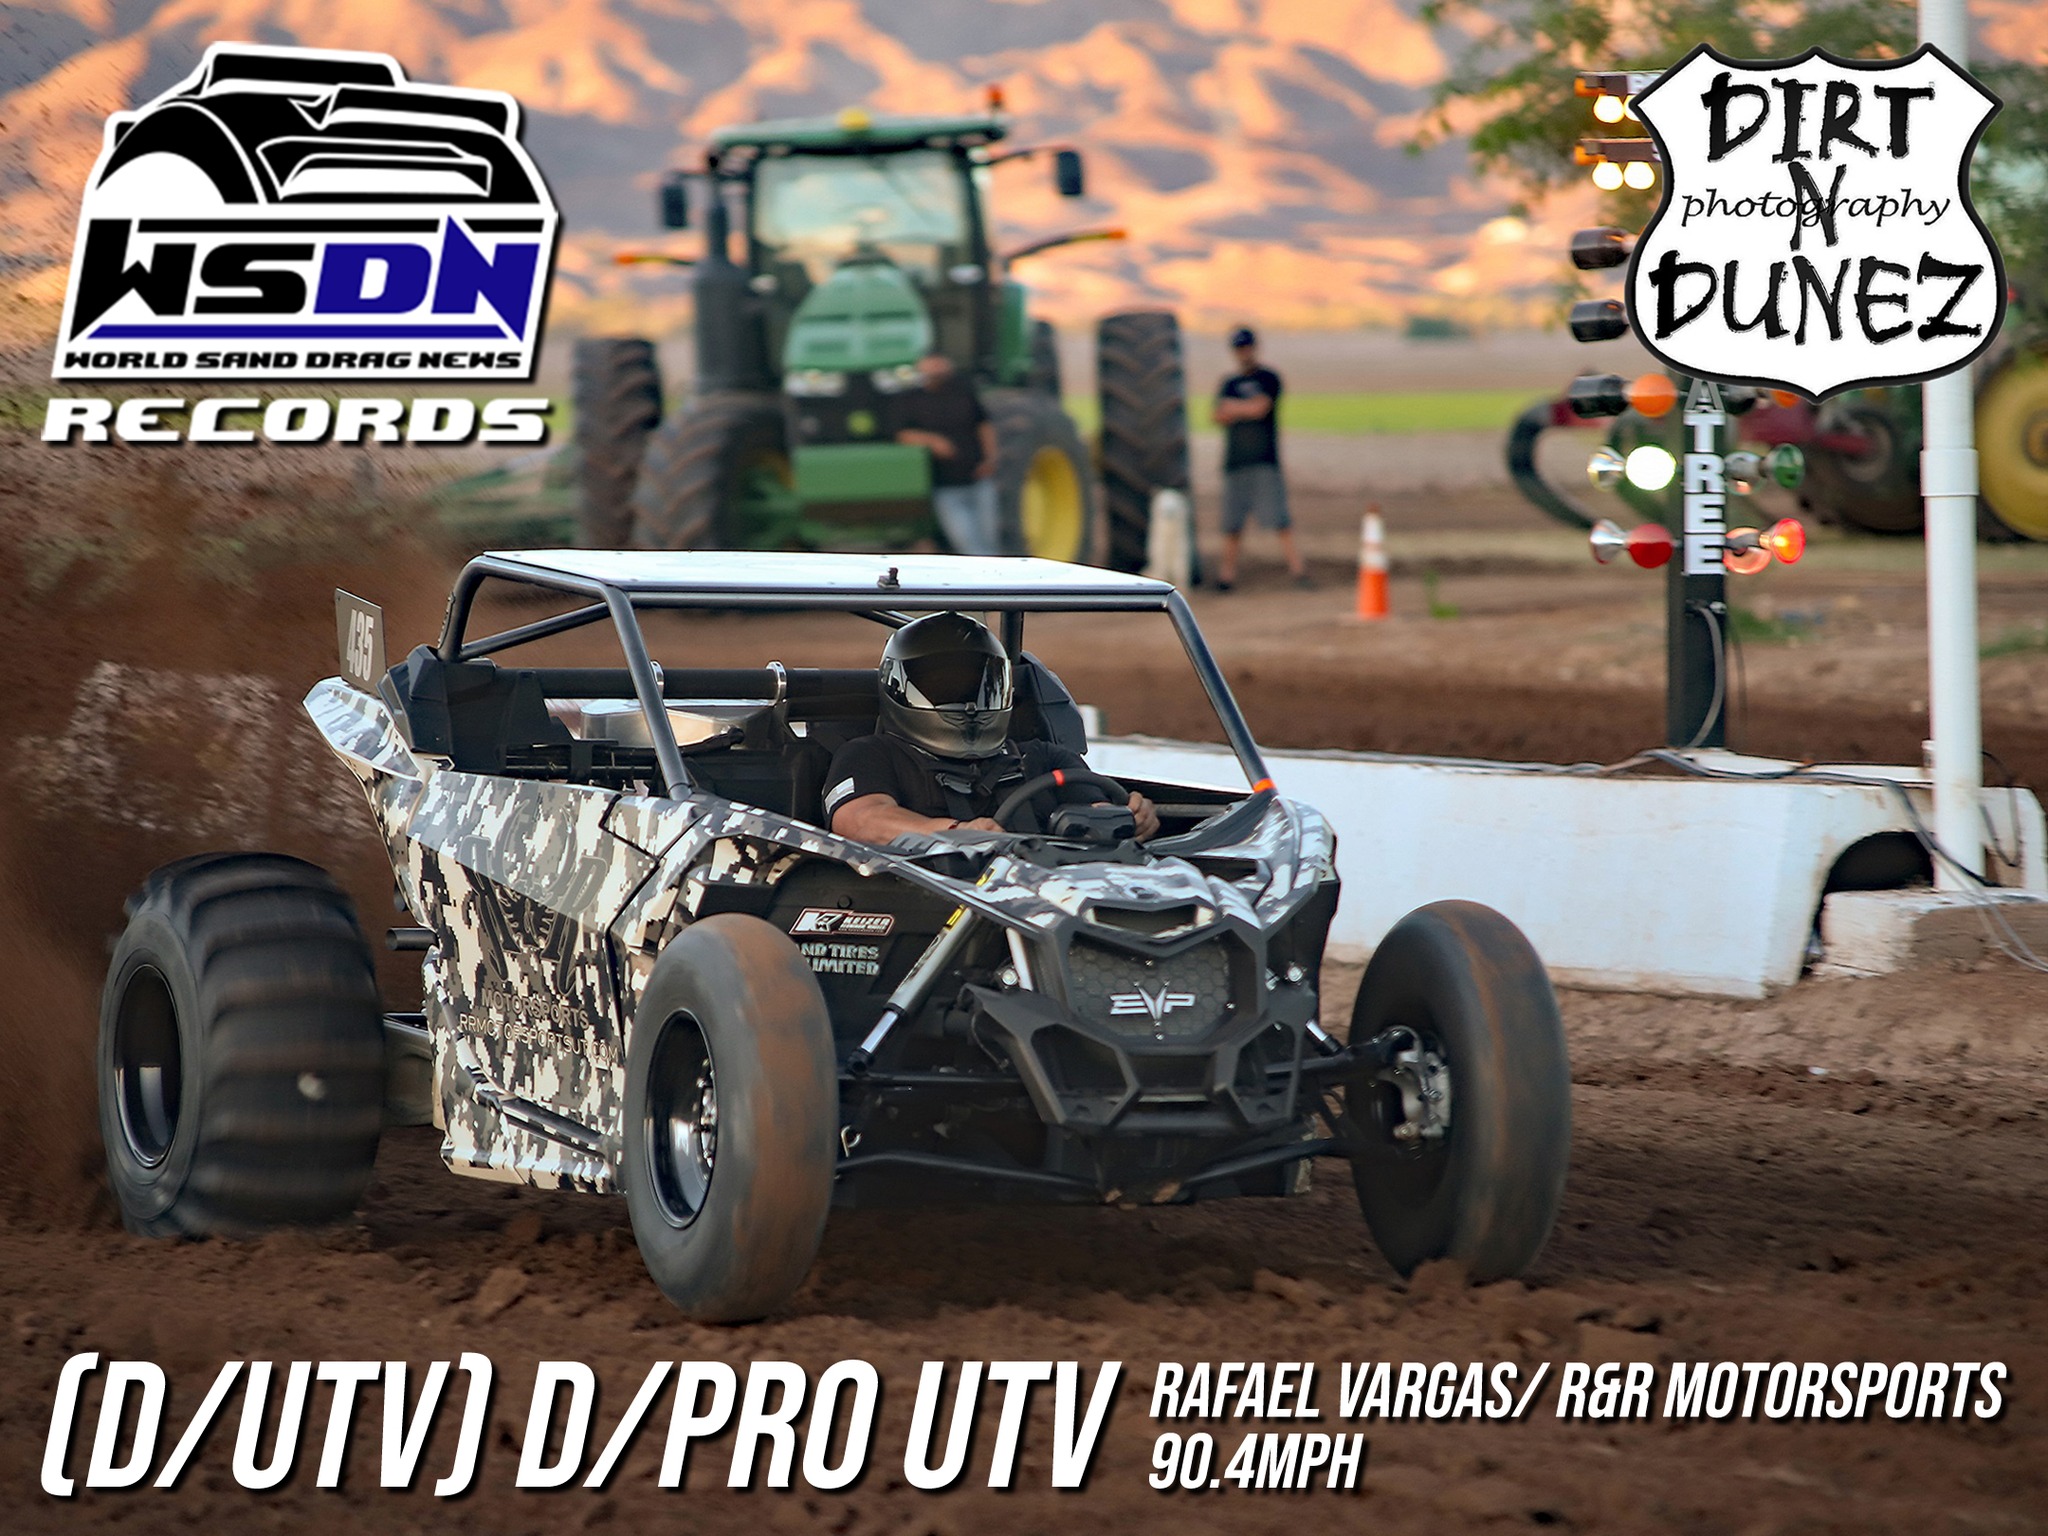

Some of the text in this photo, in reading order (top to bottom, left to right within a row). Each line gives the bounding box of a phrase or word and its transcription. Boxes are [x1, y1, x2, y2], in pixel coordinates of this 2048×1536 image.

[346, 608, 374, 681] 435
[795, 943, 879, 960] ND TIRES
[482, 988, 590, 1030] MOTORSPORTS
[1110, 982, 1196, 1024] EVP
